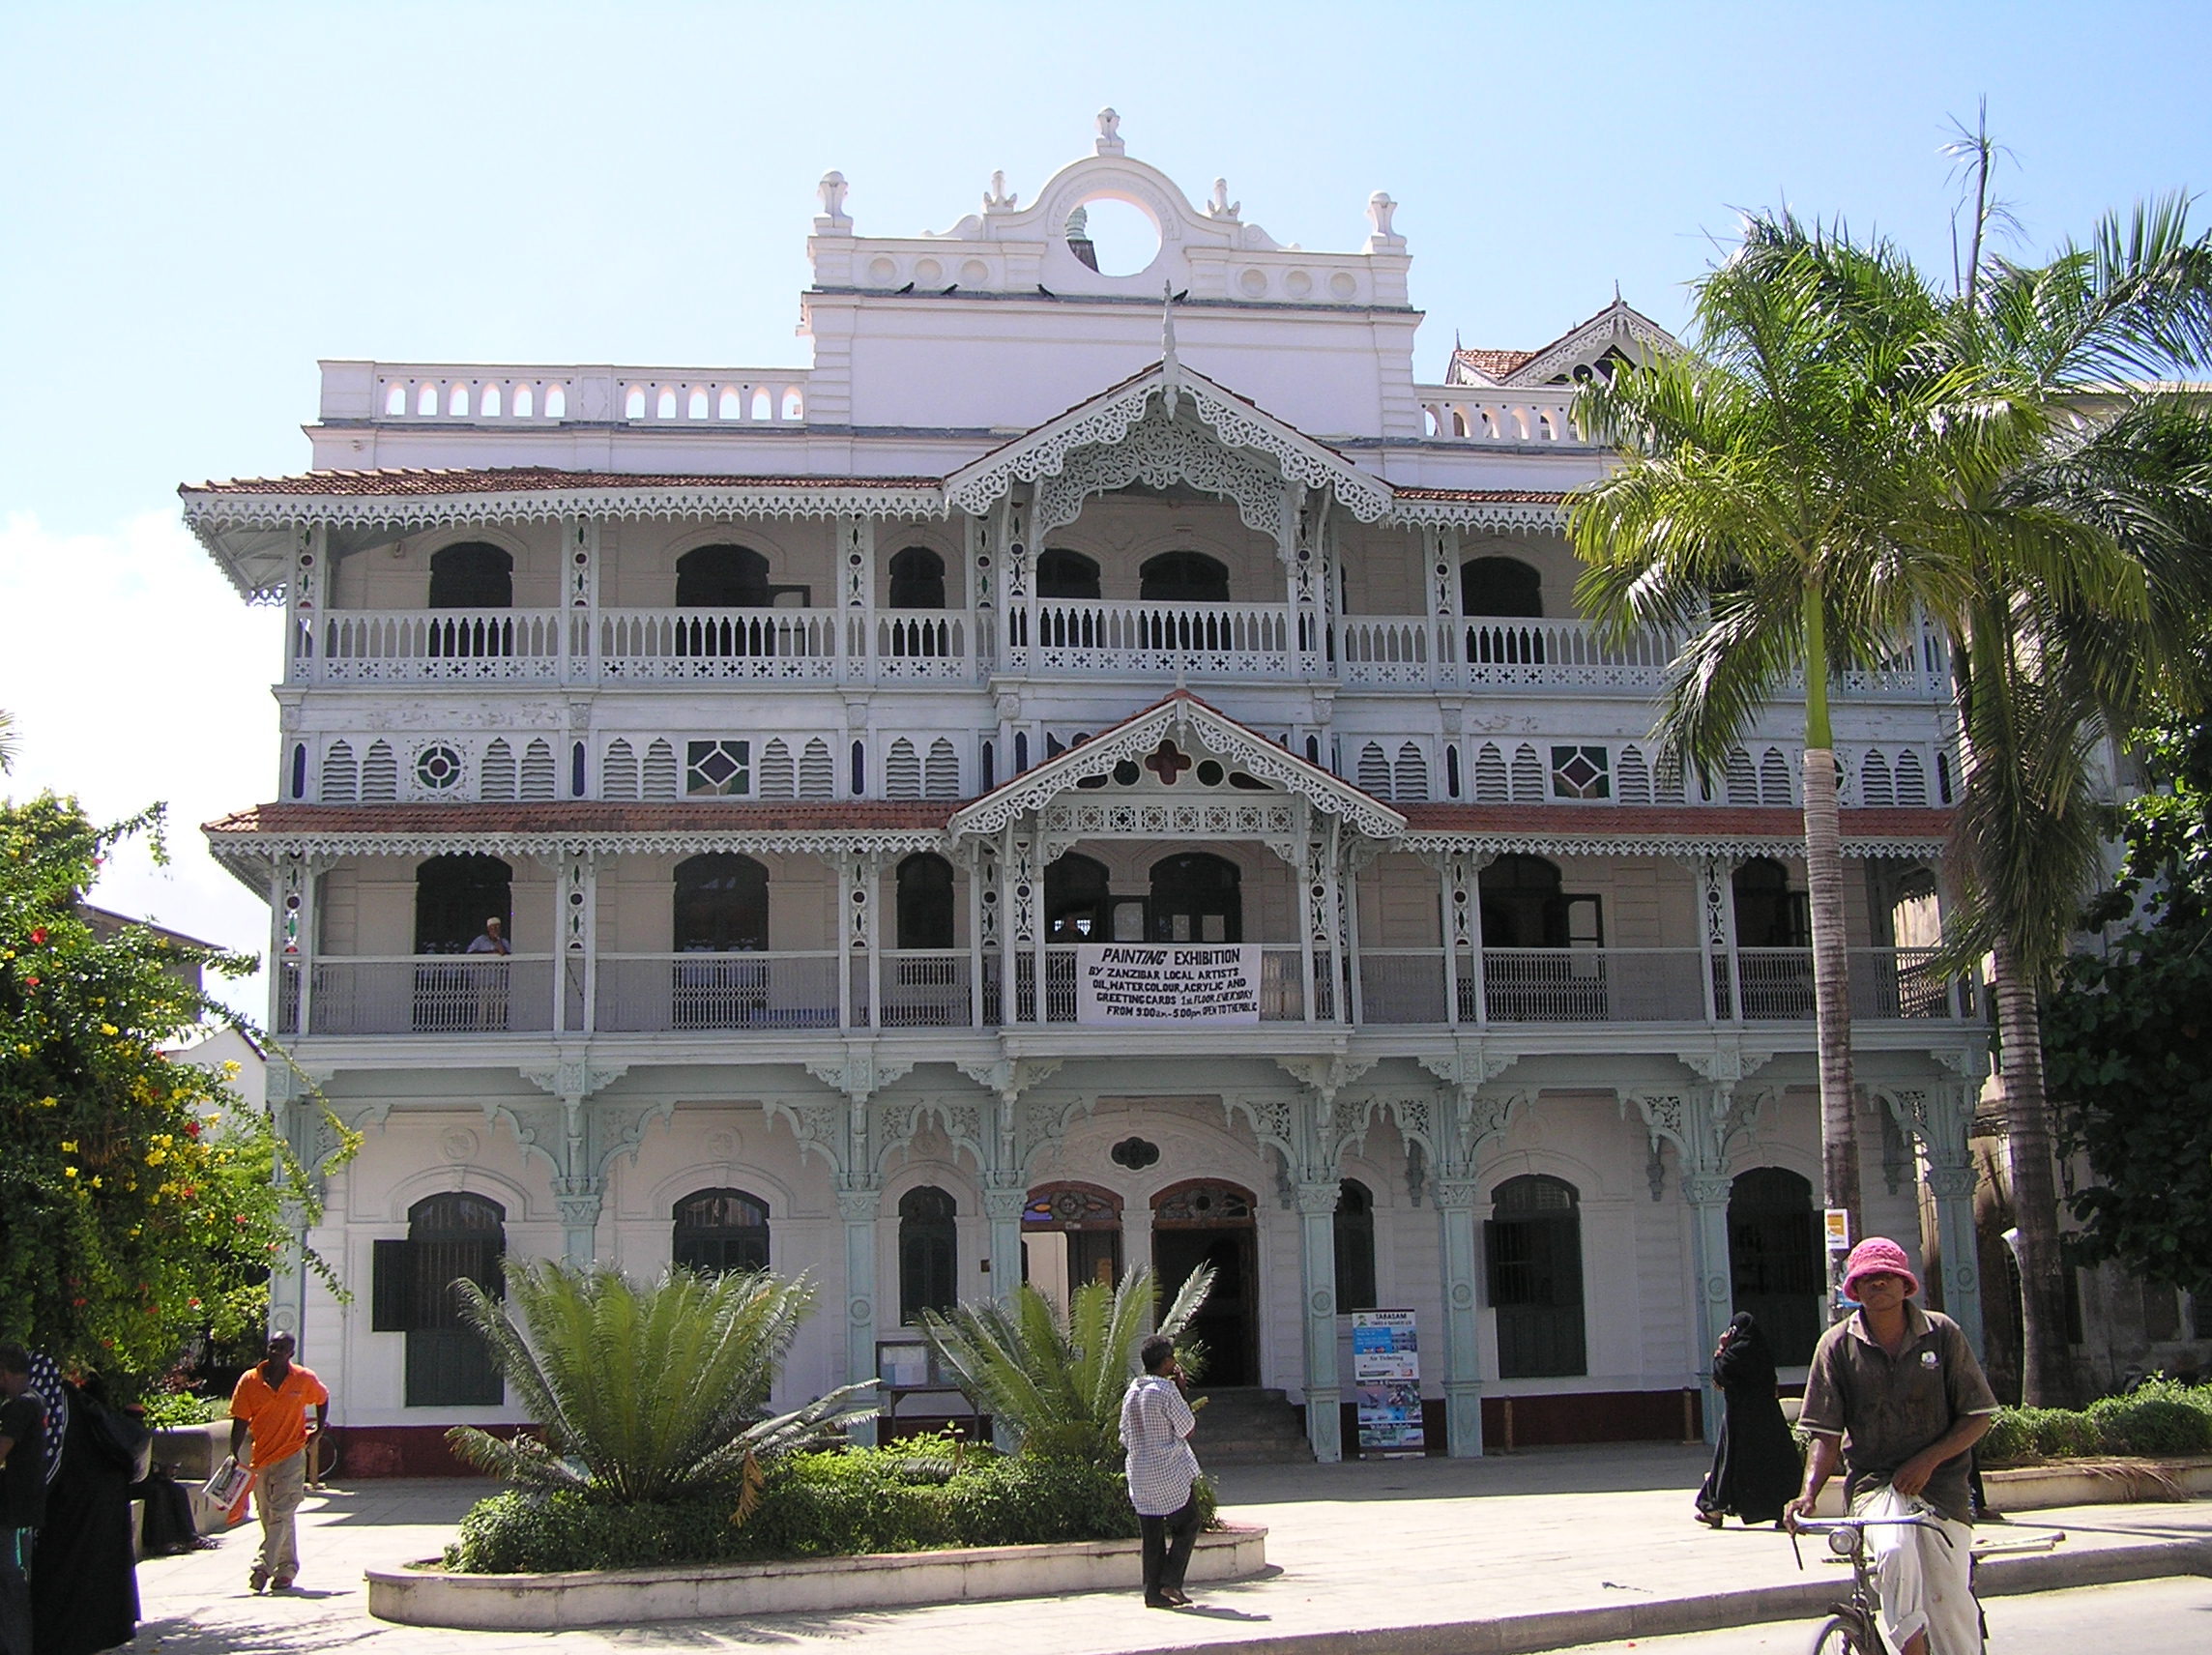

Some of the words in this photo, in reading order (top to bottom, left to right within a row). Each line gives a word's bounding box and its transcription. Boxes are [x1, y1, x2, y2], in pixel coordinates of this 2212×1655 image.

[1101, 948, 1168, 966] PAINTING
[1175, 948, 1240, 966] EXHIBITION
[1089, 967, 1103, 976] BY
[1107, 968, 1160, 980] ZANZIBAR
[1164, 971, 1194, 980] LOCAL
[1198, 968, 1239, 980] ARTISTS
[1227, 977, 1247, 989] AND
[1106, 1005, 1133, 1017] FROM
